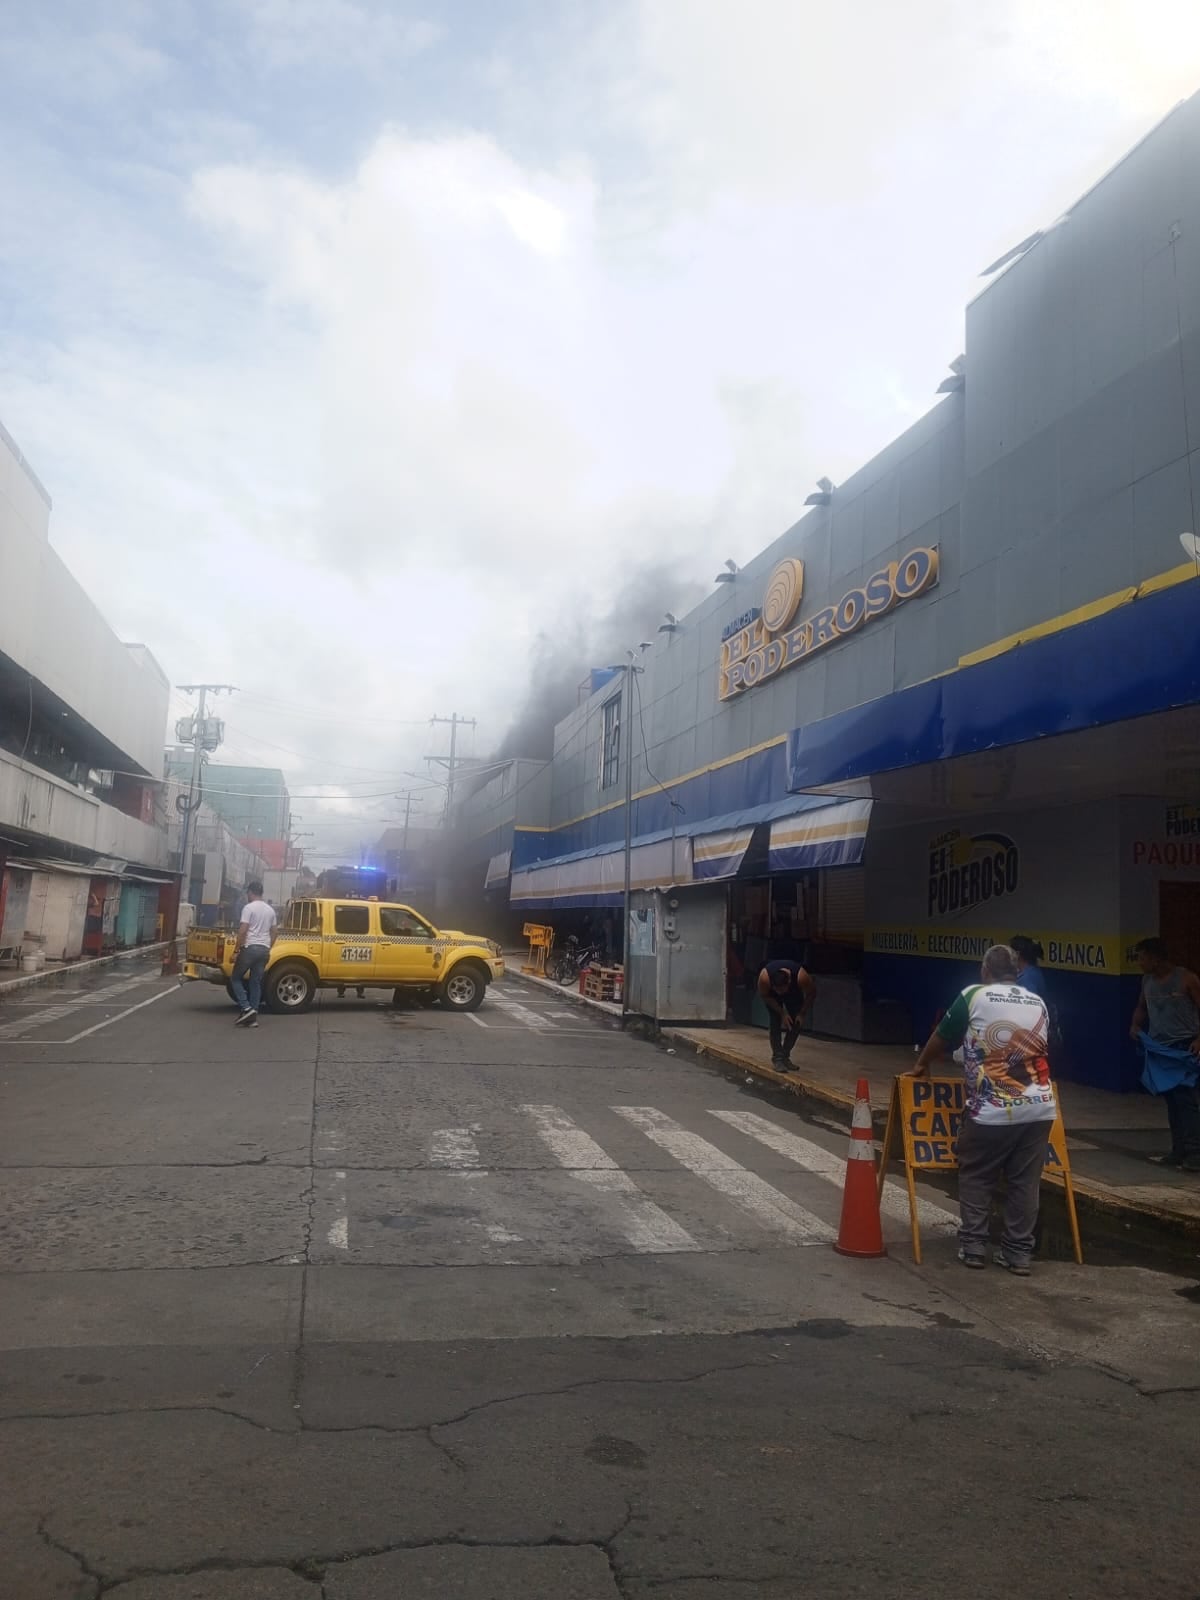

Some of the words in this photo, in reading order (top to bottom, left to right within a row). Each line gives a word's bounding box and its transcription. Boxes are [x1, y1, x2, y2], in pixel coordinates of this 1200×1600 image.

[722, 621, 763, 664] EL
[724, 548, 937, 696] PODEROSO
[928, 847, 1018, 917] PODEROSO
[1049, 941, 1106, 968] BLANCA
